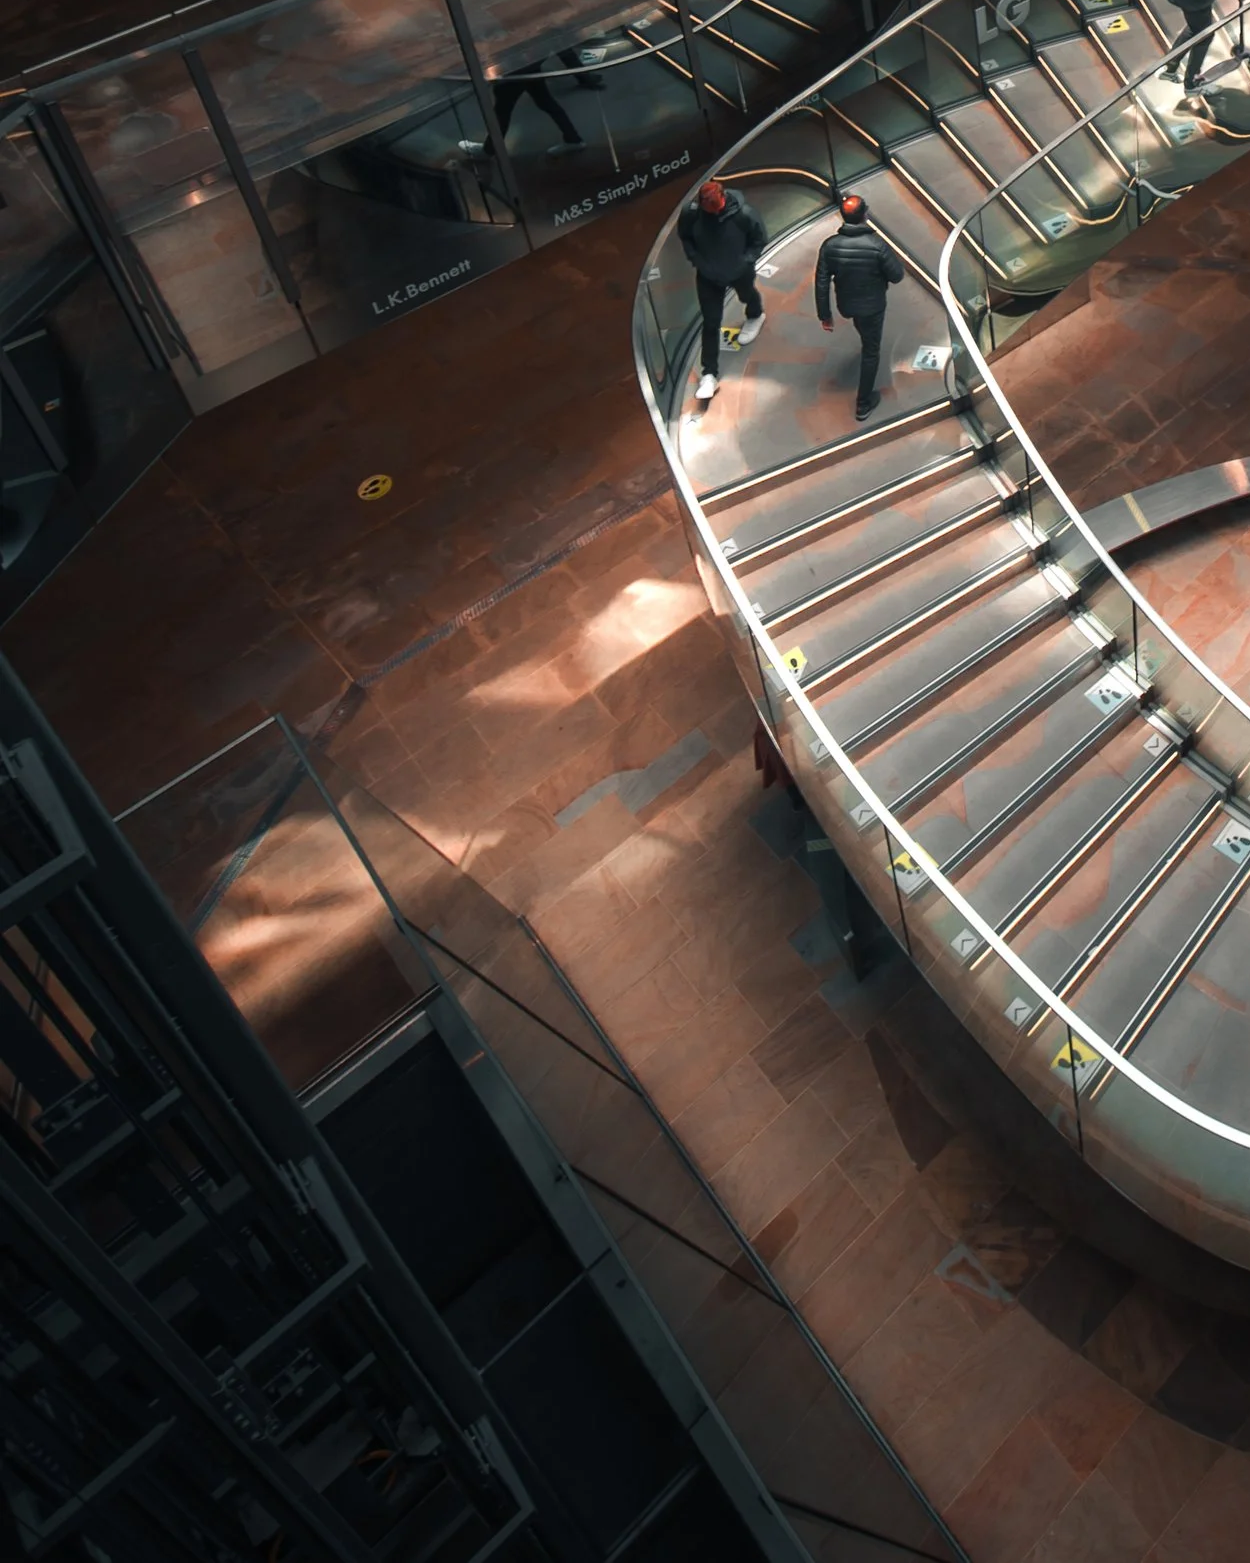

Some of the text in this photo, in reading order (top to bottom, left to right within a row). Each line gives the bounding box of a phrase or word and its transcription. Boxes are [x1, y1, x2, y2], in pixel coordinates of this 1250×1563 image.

[553, 150, 691, 227] M&S Simply Food
